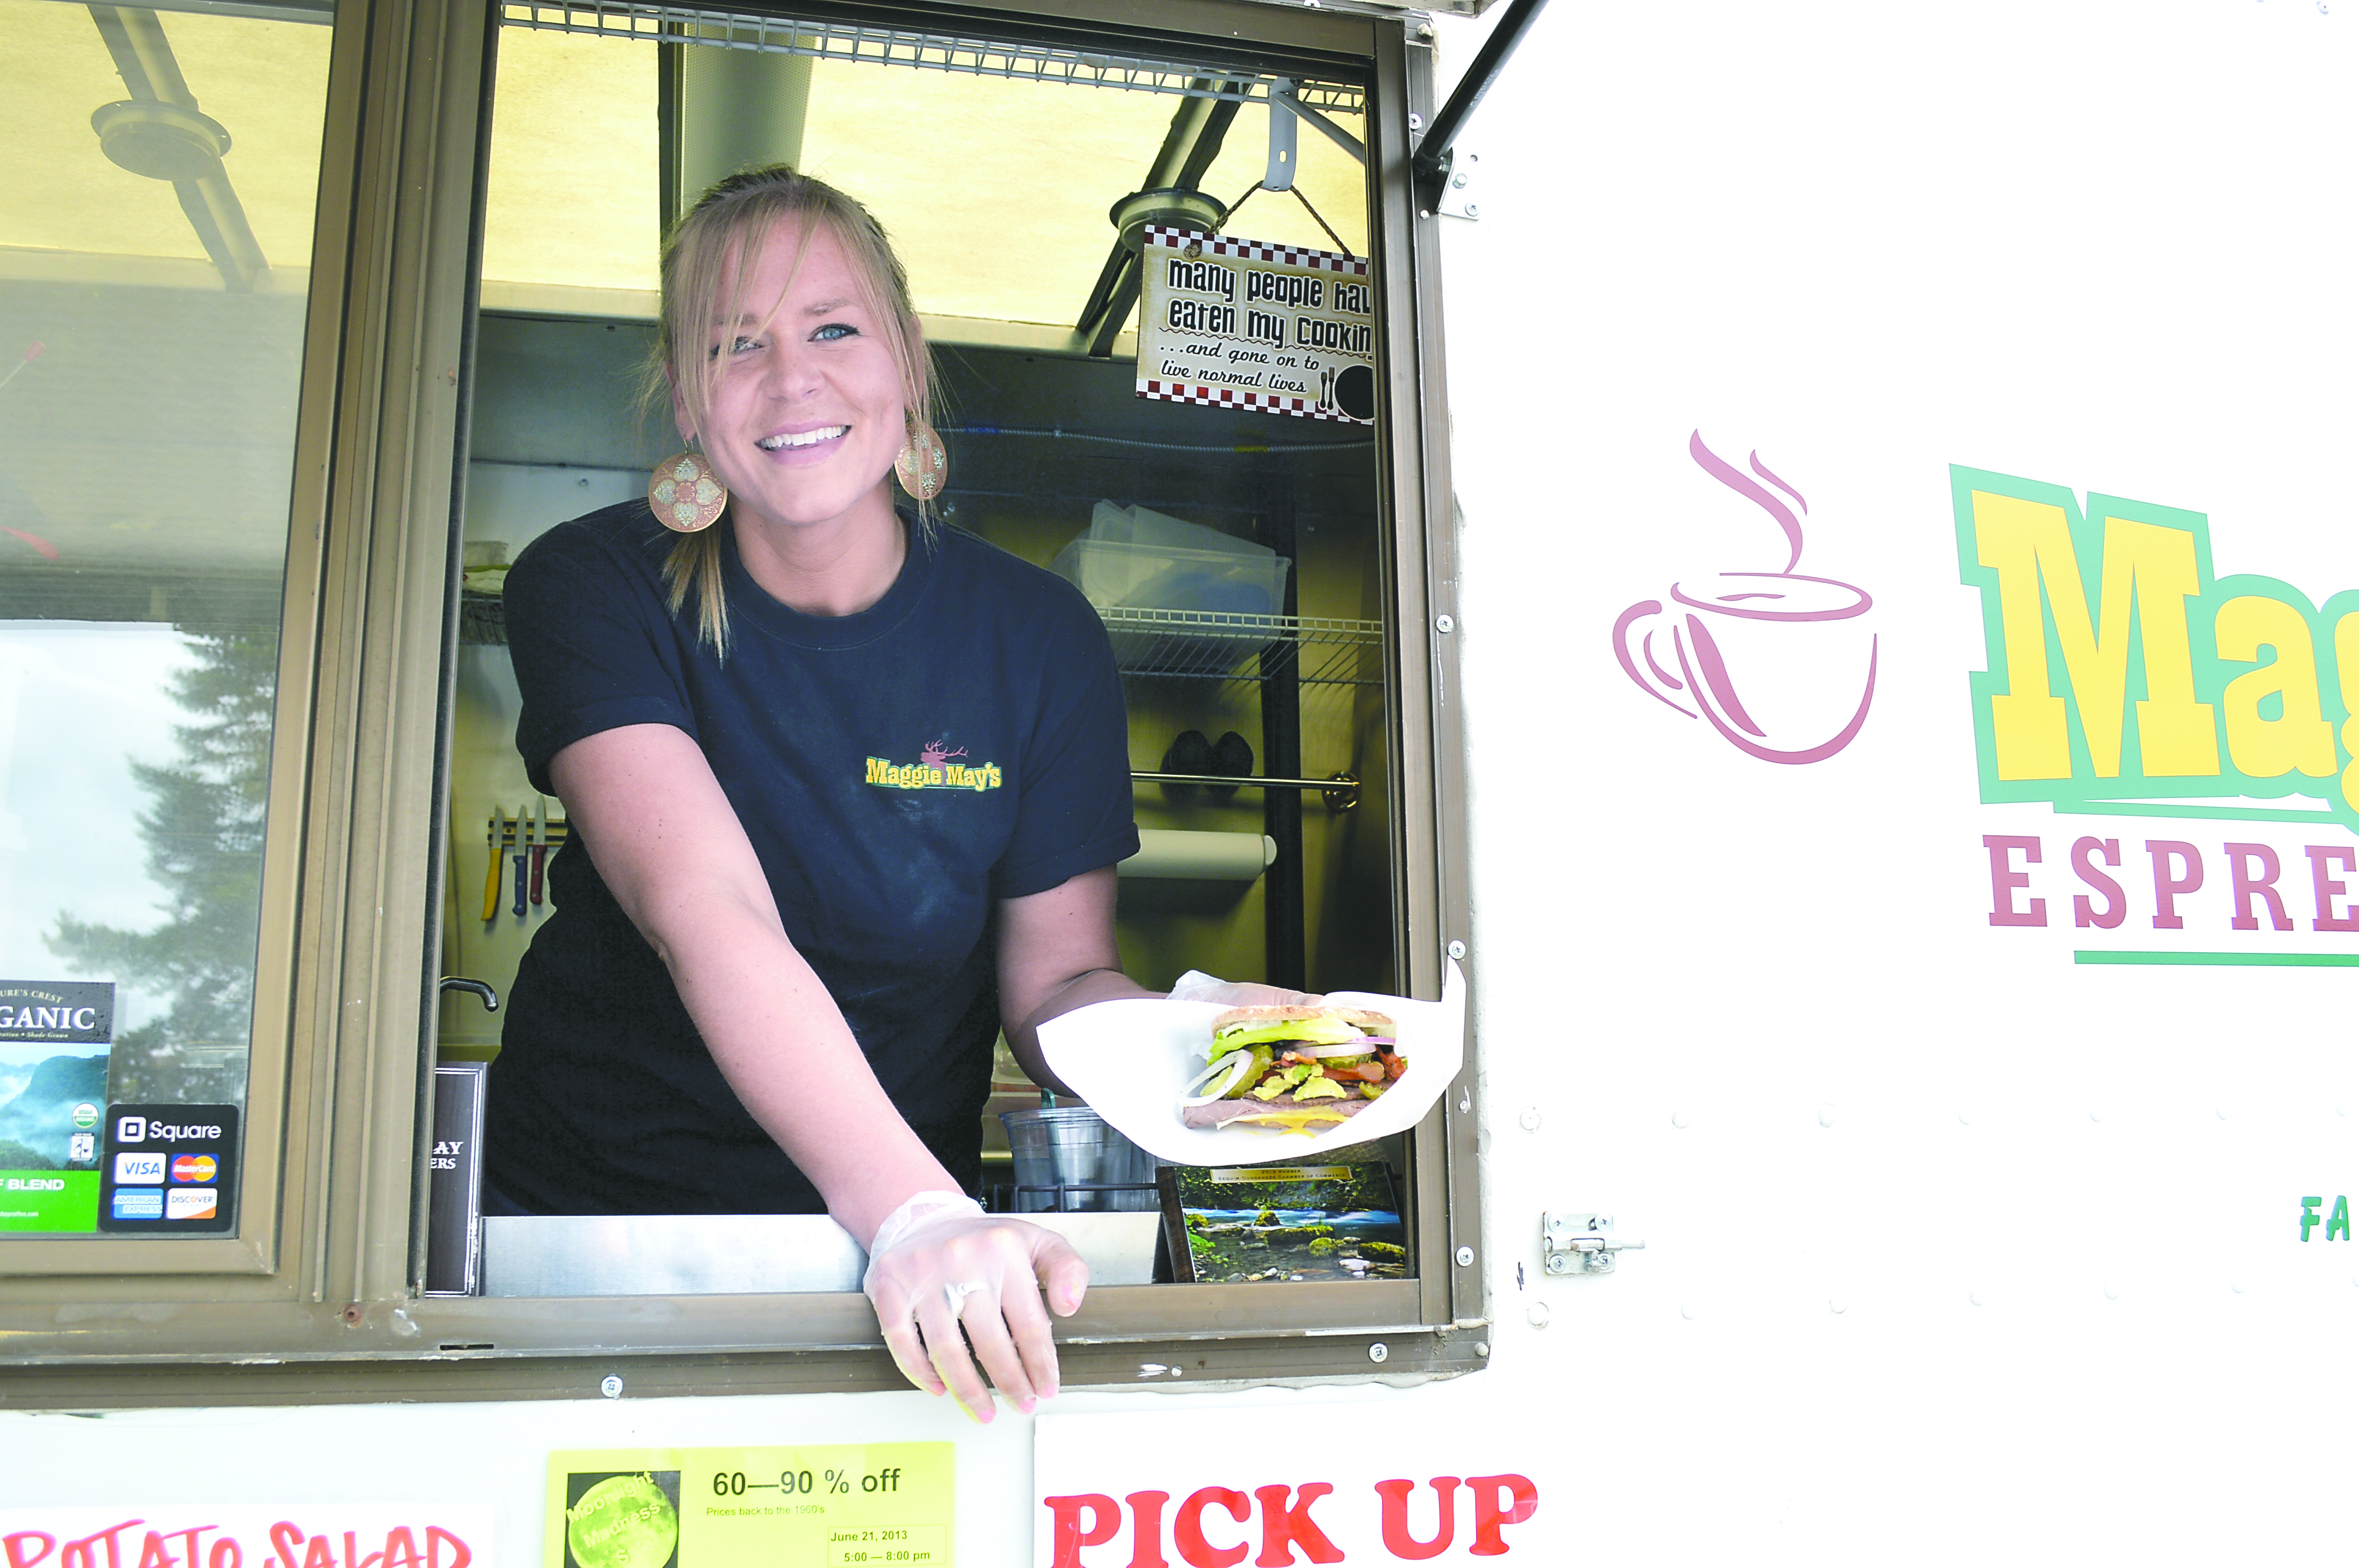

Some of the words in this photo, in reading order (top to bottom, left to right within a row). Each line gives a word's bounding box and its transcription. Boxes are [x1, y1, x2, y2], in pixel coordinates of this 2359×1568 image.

[1169, 260, 1235, 302] many
[1247, 271, 1322, 307] people
[1170, 300, 1234, 333] eaten
[1247, 310, 1285, 349] my
[1297, 317, 1372, 360] cookin
[1229, 350, 1269, 364] gone
[1277, 356, 1297, 367] on
[1304, 355, 1319, 370] to
[1162, 360, 1192, 377] live
[1198, 370, 1262, 387] normal
[1268, 374, 1307, 392] lives
[866, 757, 942, 788] Maggie
[946, 763, 1001, 791] May's
[1983, 835, 2359, 932] ESPRE
[31, 990, 63, 1003] CREST
[0, 1006, 95, 1029] GANIC
[149, 1121, 222, 1143] Square
[123, 1162, 161, 1174] VISA
[174, 1165, 216, 1173] MasterCard
[8, 1179, 65, 1190] BLEND
[124, 1204, 163, 1213] EXPRESS
[2300, 1195, 2350, 1242] FA
[861, 1468, 900, 1492] off
[566, 1471, 654, 1524] Moonlight
[706, 1507, 736, 1516] Prices
[739, 1506, 761, 1515] back
[764, 1507, 773, 1515] to
[776, 1506, 791, 1515] the
[795, 1505, 824, 1514] 1960's
[1044, 1482, 1345, 1568] PICK
[1375, 1474, 1539, 1560] UP
[583, 1503, 661, 1548] Madness
[831, 1532, 858, 1542] June
[862, 1531, 878, 1542] 21,
[881, 1530, 907, 1540] 2013
[844, 1552, 867, 1562] 5:00
[886, 1551, 909, 1561] 8:00
[913, 1552, 930, 1562] pm
